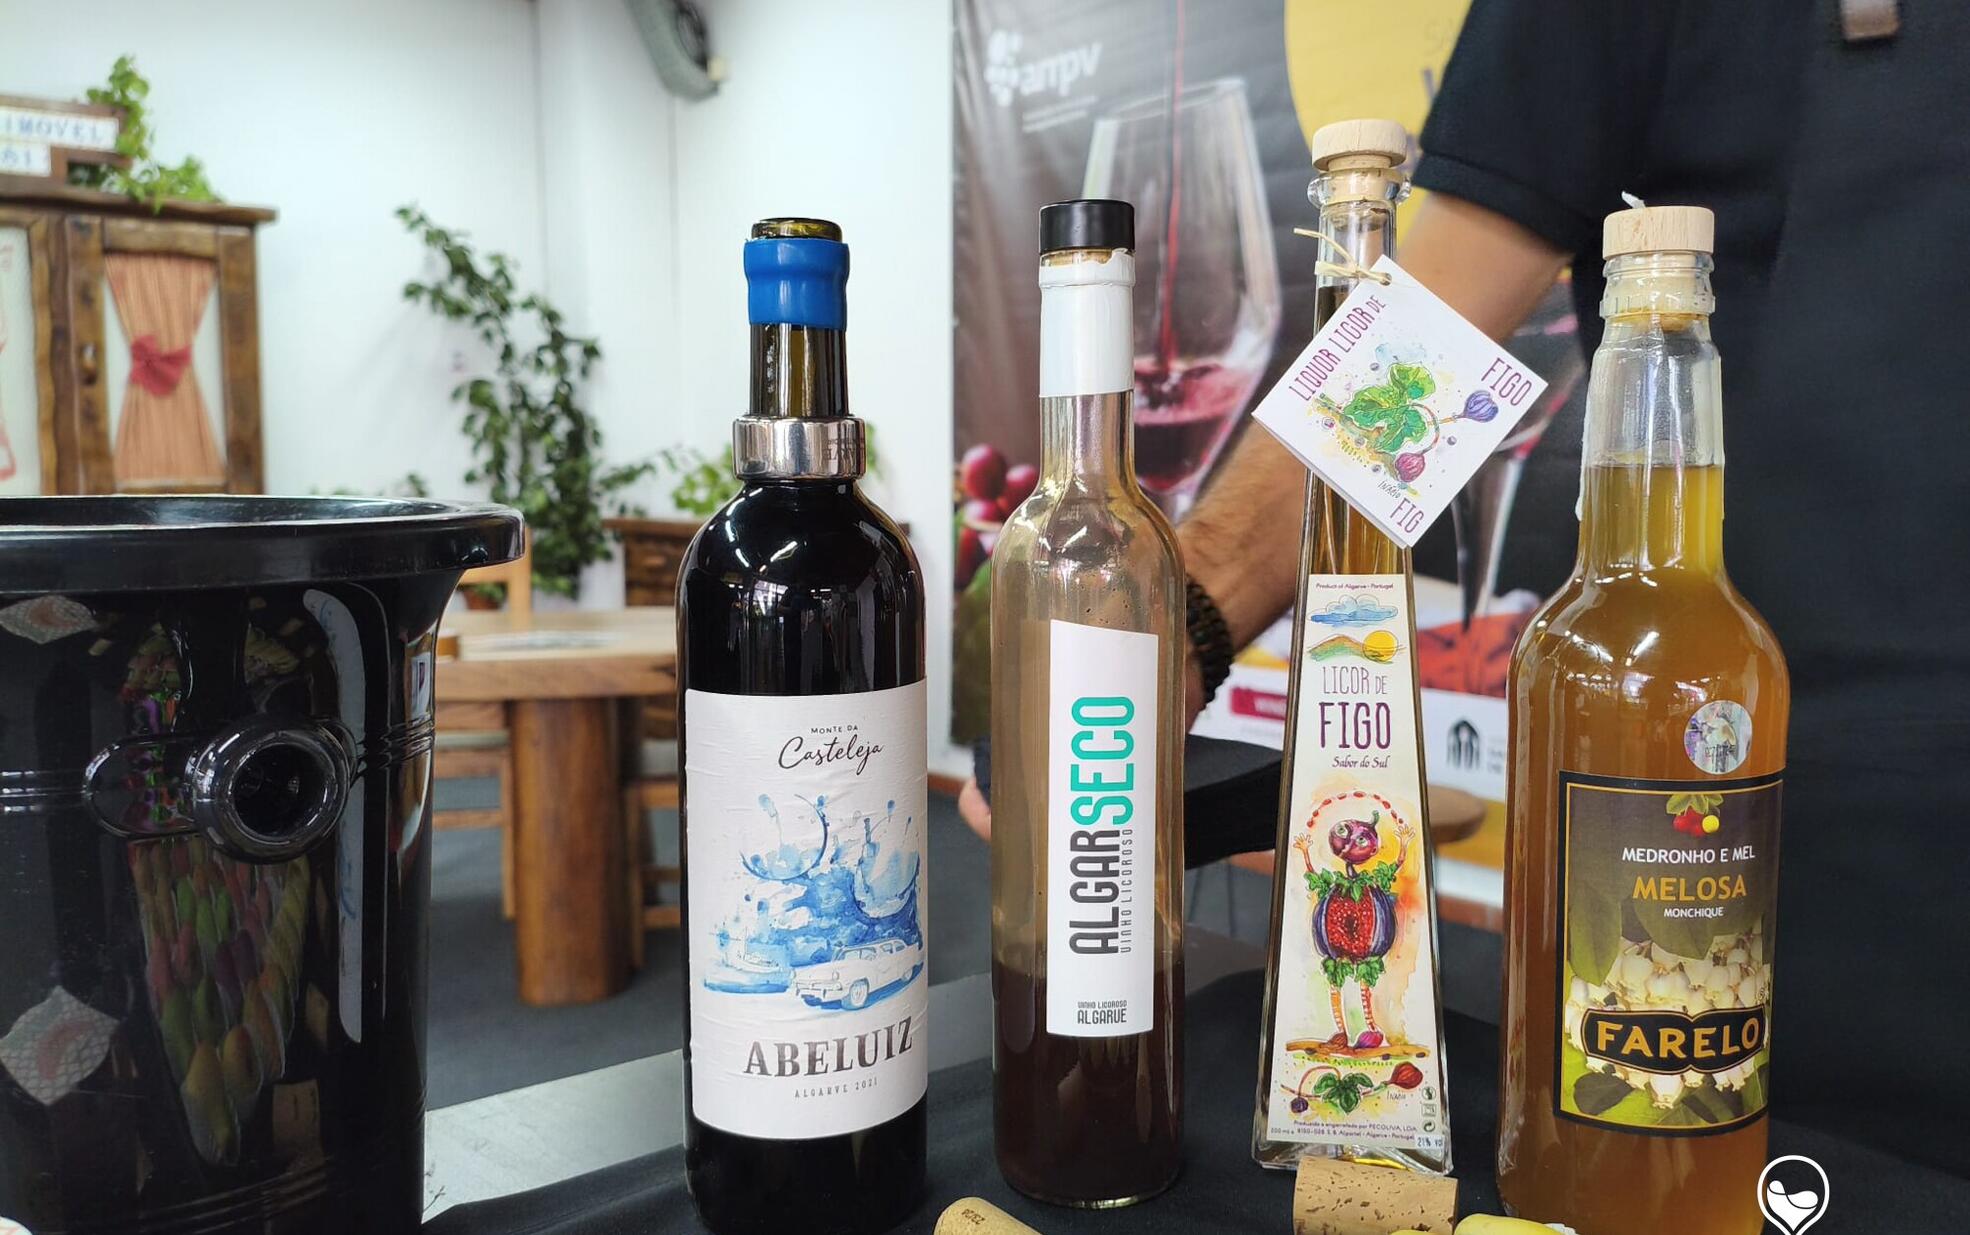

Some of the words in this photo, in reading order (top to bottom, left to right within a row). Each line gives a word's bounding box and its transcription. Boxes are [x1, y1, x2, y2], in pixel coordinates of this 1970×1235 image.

[1288, 347, 1342, 401] LIQUOR
[1365, 294, 1386, 314] DE
[1480, 357, 1533, 407] FIGO
[1389, 497, 1425, 534] FIG
[1322, 665, 1370, 695] LICOR
[1374, 675, 1388, 695] DE
[810, 726, 843, 735] MONTE
[1318, 701, 1391, 750] FIGO
[778, 733, 885, 776] Casteleja
[1332, 754, 1358, 768] Sabor
[1360, 755, 1370, 768] do
[1371, 755, 1391, 769] Sul
[1121, 829, 1133, 903] LICOROSO
[1622, 847, 1716, 864] MEDRONHO
[1720, 848, 1729, 863] E
[1732, 845, 1756, 861] MEL
[1632, 874, 1747, 901] MELOSA
[1663, 907, 1724, 919] MONCHIQUE
[1097, 1000, 1128, 1009] LICOROSO
[743, 1016, 913, 1077] ABELUIZ
[1597, 1017, 1760, 1059] FARELO
[794, 1084, 849, 1098] ALGARVE
[855, 1077, 878, 1091] 2021
